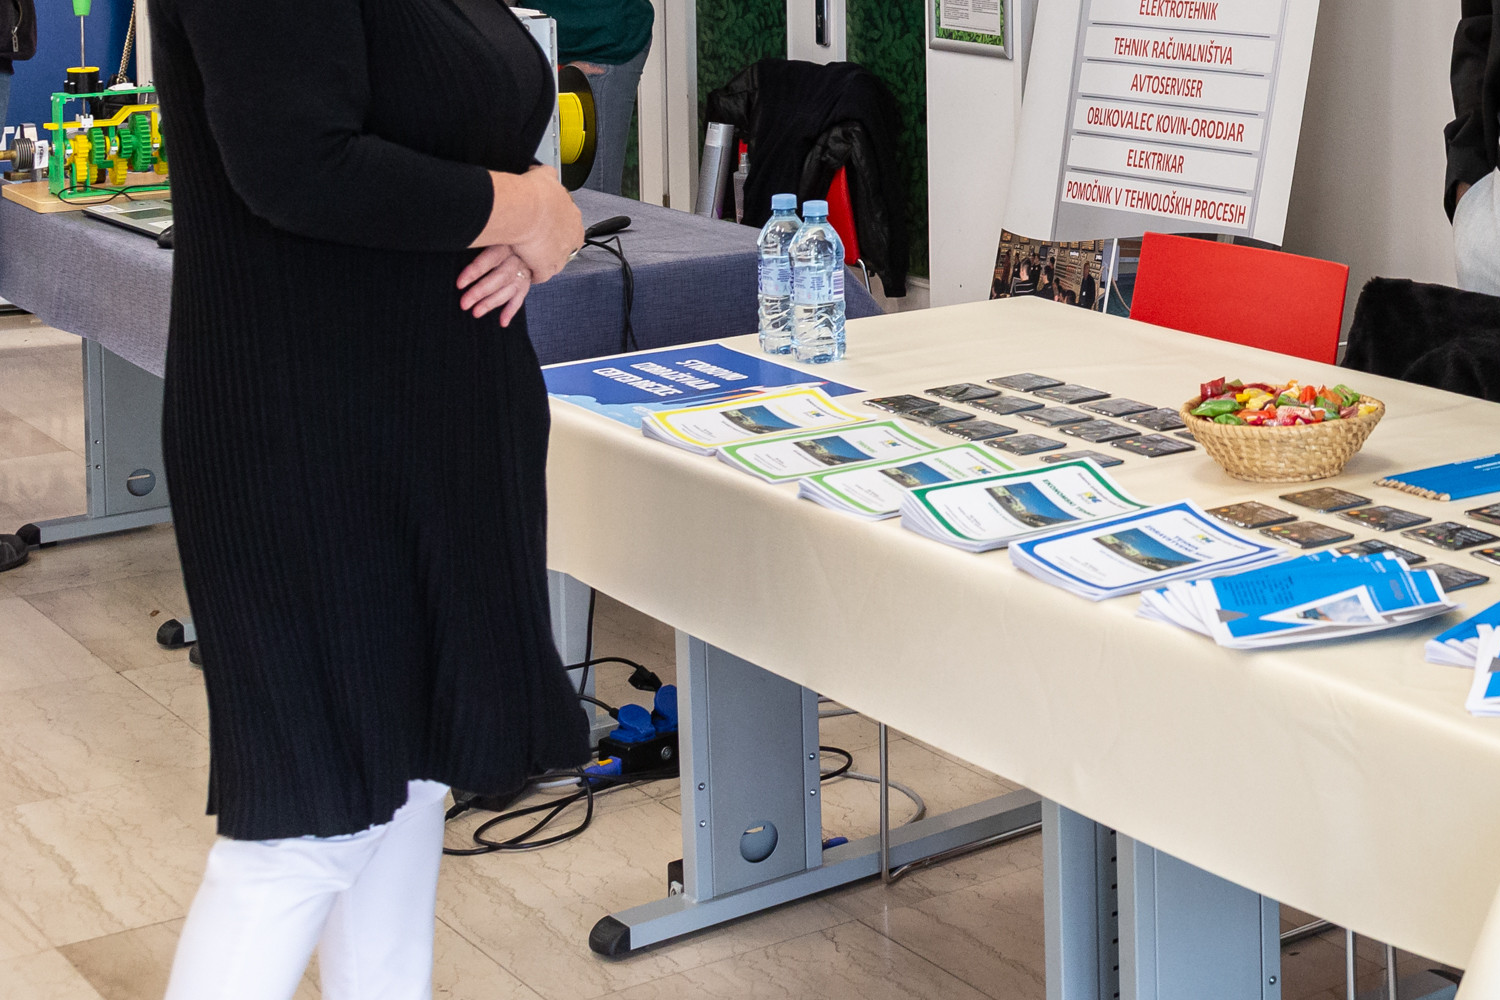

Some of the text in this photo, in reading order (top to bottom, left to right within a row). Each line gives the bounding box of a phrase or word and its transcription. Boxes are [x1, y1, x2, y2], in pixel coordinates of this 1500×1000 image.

[1114, 36, 1233, 66] TEHNIK RAČUNALNIŠTVA
[1130, 74, 1204, 98] AVTOSERVISER
[1087, 106, 1245, 142] OBLIKOVALEC KOVIN-ORODJAR
[1126, 148, 1185, 174] ELEKTRIKAR
[1066, 179, 1247, 225] POMOČNIK V TEHNOLOŠKIH PROCESIH
